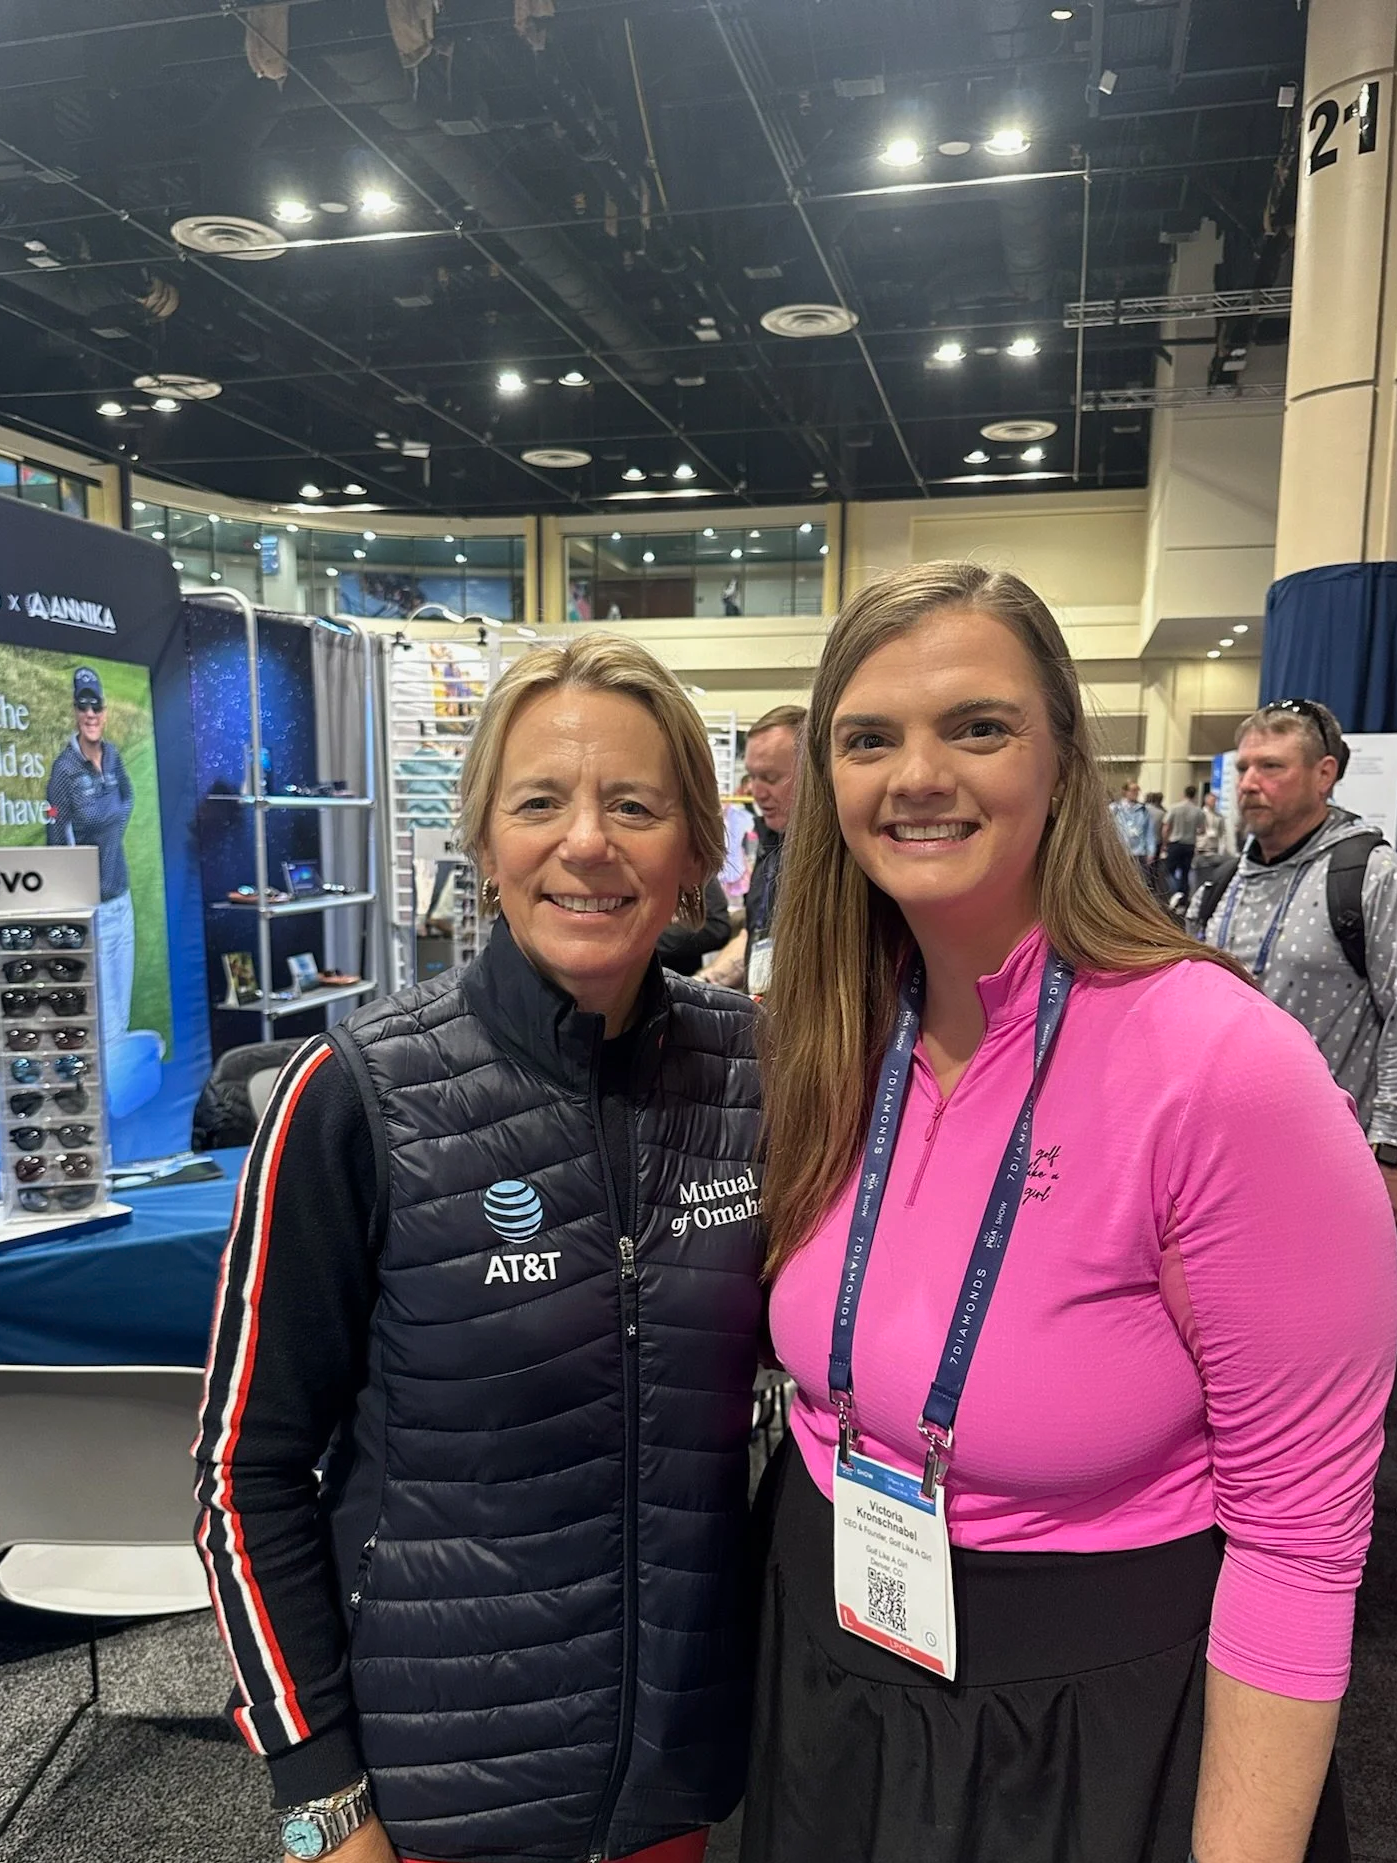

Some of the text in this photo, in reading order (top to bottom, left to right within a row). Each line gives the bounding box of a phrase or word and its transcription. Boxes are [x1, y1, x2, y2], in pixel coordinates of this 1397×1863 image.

[1306, 82, 1379, 176] 21
[50, 595, 117, 630] ANNIKA
[0, 694, 31, 731] he
[21, 751, 46, 778] as
[0, 871, 43, 893] VO
[1036, 1145, 1062, 1168] golf
[678, 1167, 759, 1206] Mutual
[1022, 1186, 1052, 1206] girl
[670, 1211, 692, 1238] of
[994, 1200, 1008, 1226] SHOW
[484, 1250, 562, 1285] AT&T
[843, 1517, 857, 1529] CEO
[856, 1506, 918, 1541] Kronschnabel
[868, 1499, 904, 1523] Victoria
[844, 1609, 854, 1627] L
